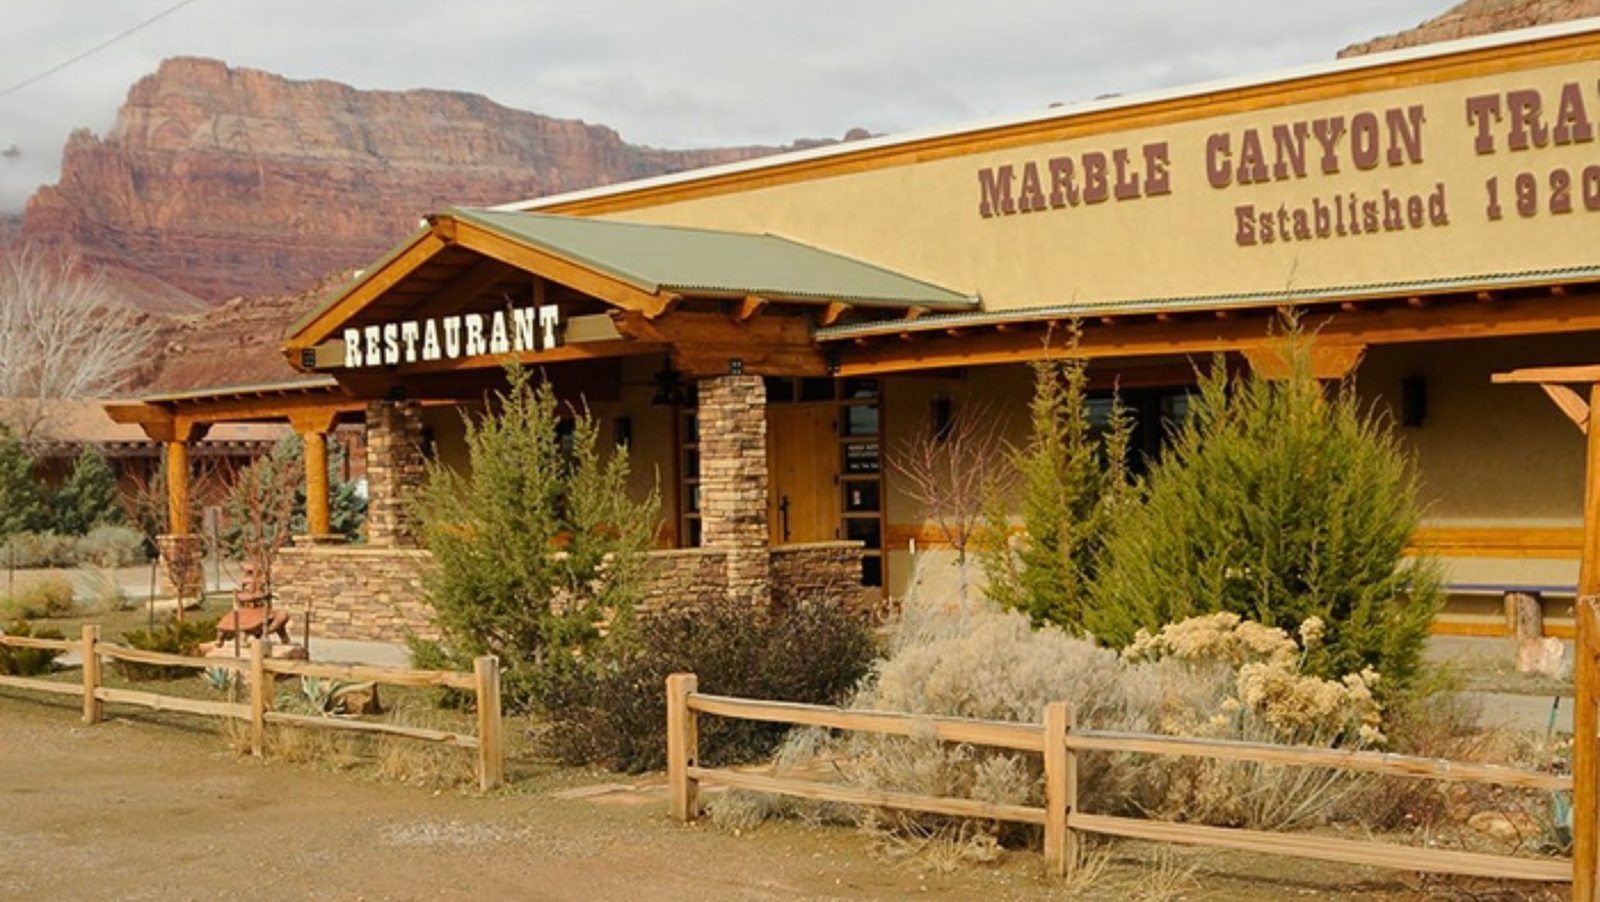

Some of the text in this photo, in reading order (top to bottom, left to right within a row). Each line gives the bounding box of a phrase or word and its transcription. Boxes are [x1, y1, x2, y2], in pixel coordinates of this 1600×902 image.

[978, 78, 1600, 218] MARBLE CANYON TRA
[1235, 164, 1600, 247] Established 1920
[344, 304, 559, 368] RESTAURANT
